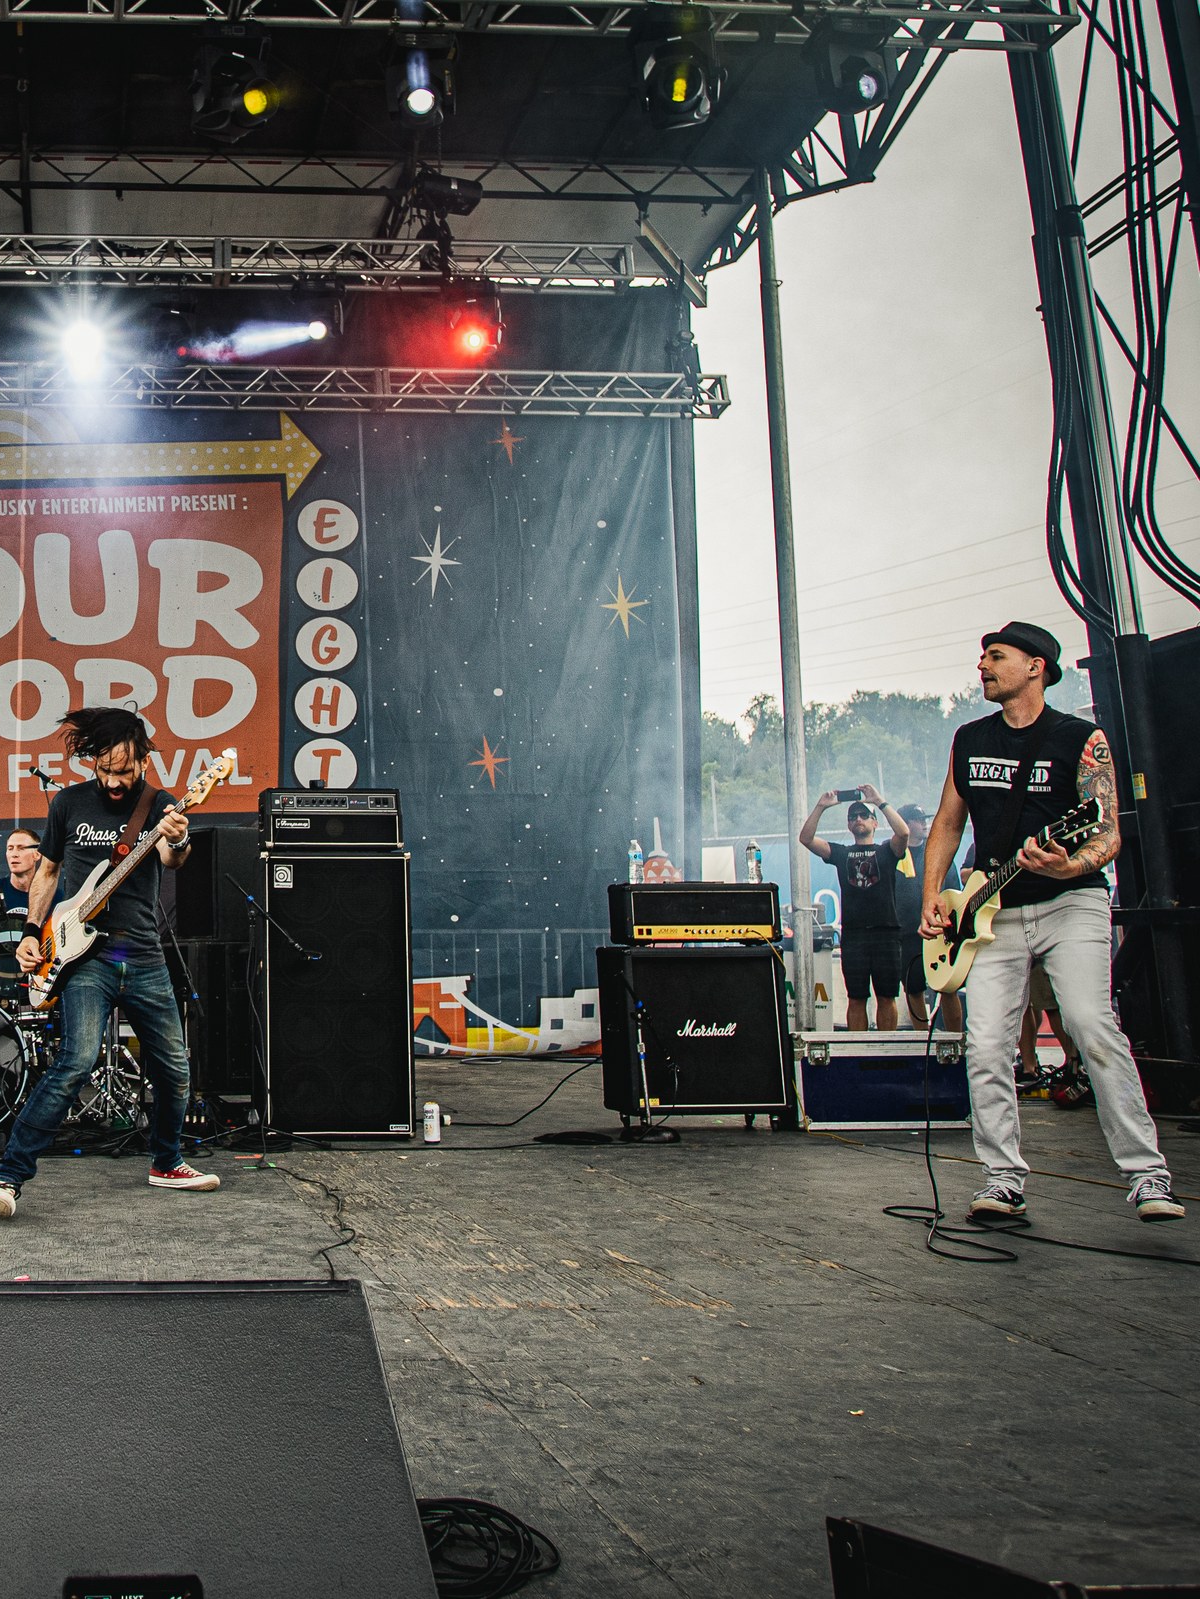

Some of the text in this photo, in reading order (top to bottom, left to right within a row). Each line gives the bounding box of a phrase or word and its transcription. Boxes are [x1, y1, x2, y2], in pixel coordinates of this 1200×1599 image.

[42, 496, 166, 515] ENTERTAINMENT
[171, 494, 237, 512] PRESENT
[7, 747, 253, 793] FESVAL
[75, 822, 118, 844] Phase
[676, 1019, 737, 1037] Marshall
